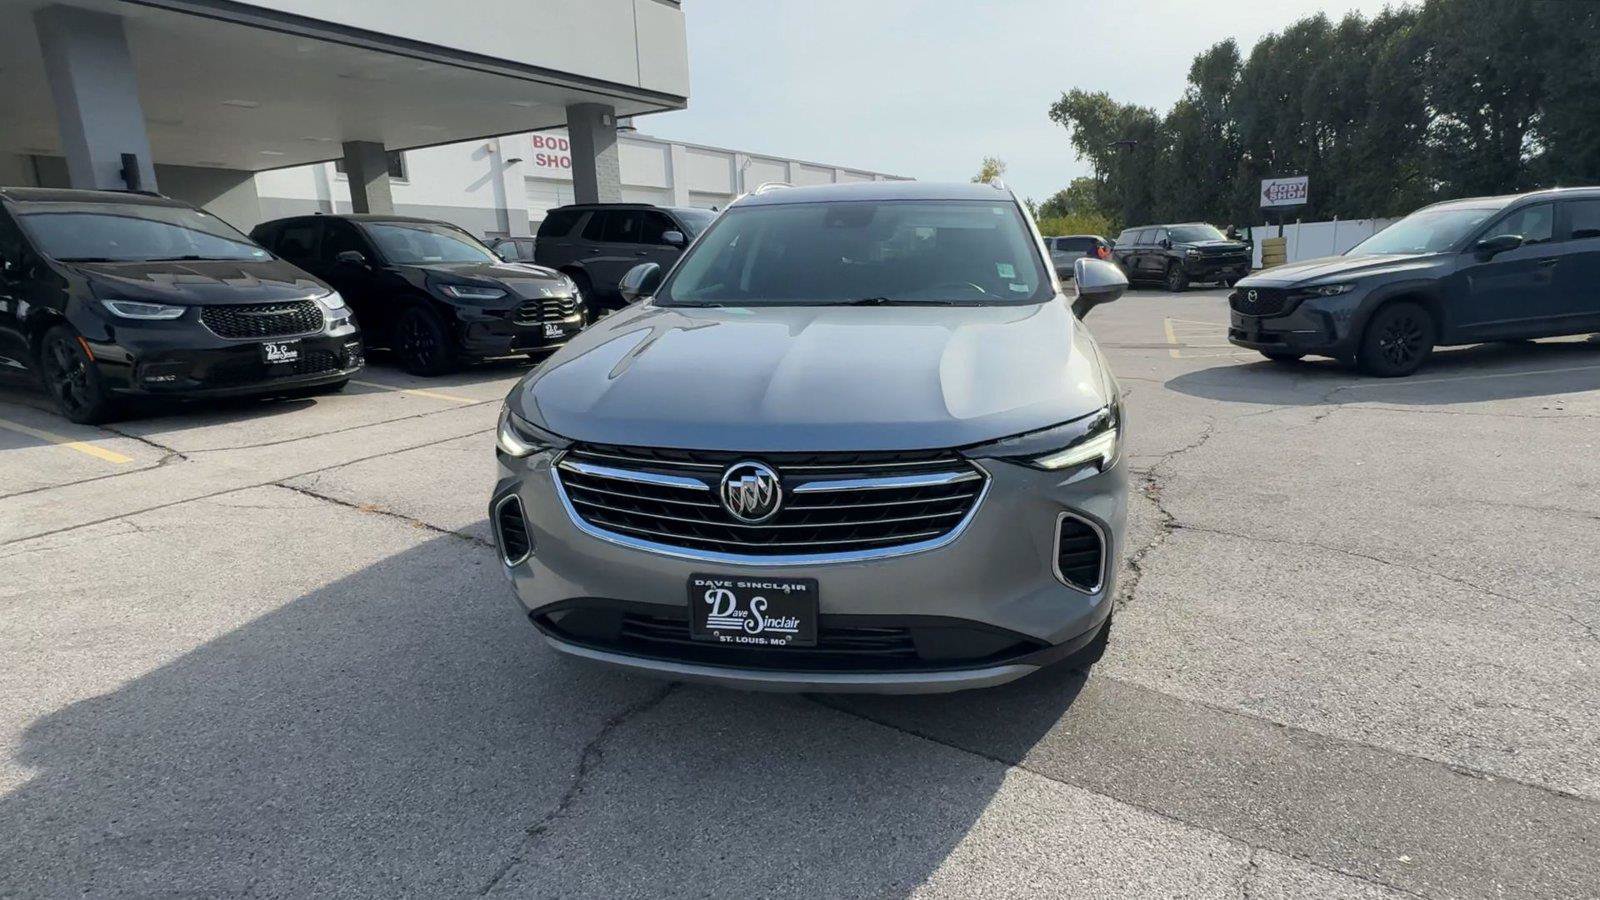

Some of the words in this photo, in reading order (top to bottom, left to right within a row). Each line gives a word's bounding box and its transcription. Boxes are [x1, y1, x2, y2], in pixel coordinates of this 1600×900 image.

[533, 135, 568, 151] BOD
[536, 153, 571, 169] SHO
[1270, 183, 1305, 193] BODY
[1270, 190, 1305, 200] SHOP
[737, 582, 806, 591] SINCLAIR
[704, 589, 748, 617] Dave
[744, 596, 800, 634] Sinclair
[719, 635, 733, 643] ST.
[770, 638, 786, 646] MO
